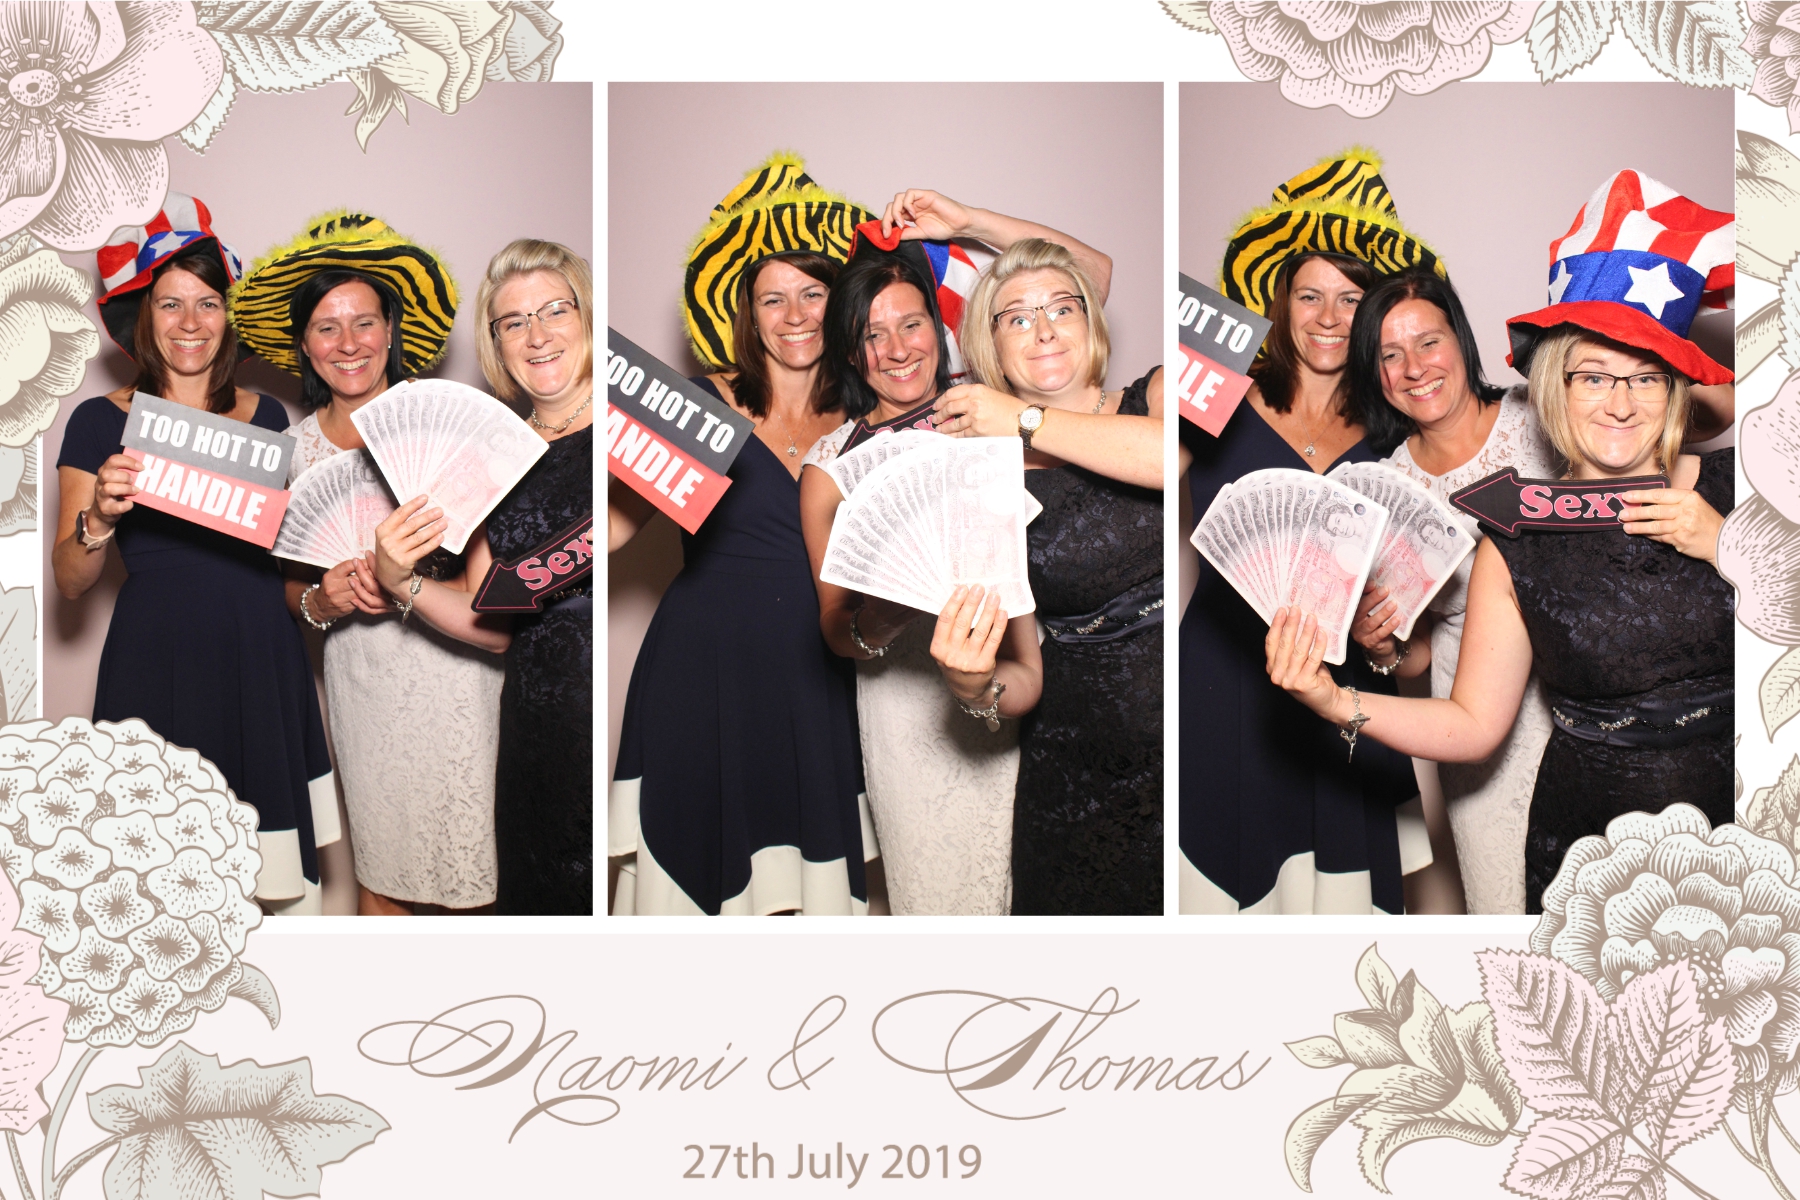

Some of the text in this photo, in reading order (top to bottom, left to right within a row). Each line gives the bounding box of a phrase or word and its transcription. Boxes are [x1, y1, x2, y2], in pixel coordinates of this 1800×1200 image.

[1179, 290, 1253, 353] OT TO
[139, 410, 282, 472] TOO HOT TO
[640, 378, 701, 430] HOT
[696, 411, 735, 453] TO
[134, 453, 267, 530] HANDLE
[608, 402, 704, 509] ANDLE
